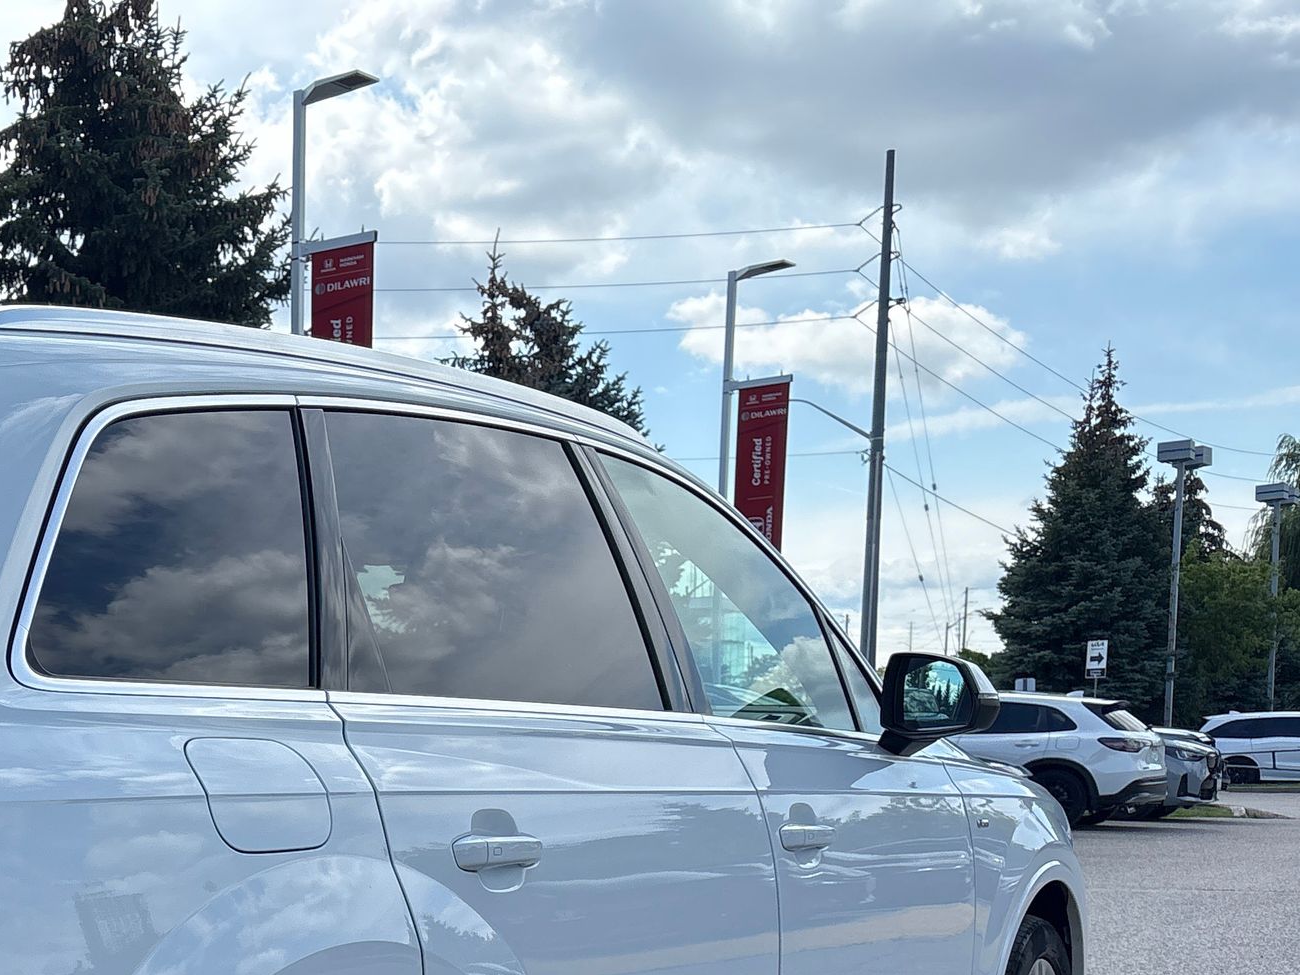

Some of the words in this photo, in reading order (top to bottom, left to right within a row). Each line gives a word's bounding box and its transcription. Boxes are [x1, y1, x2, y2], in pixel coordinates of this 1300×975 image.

[326, 276, 371, 292] DILAWRI
[750, 408, 787, 419] DILAWRI
[751, 438, 764, 486] Certified
[763, 435, 772, 485] PRE-OWNED
[765, 504, 773, 543] ONDA
